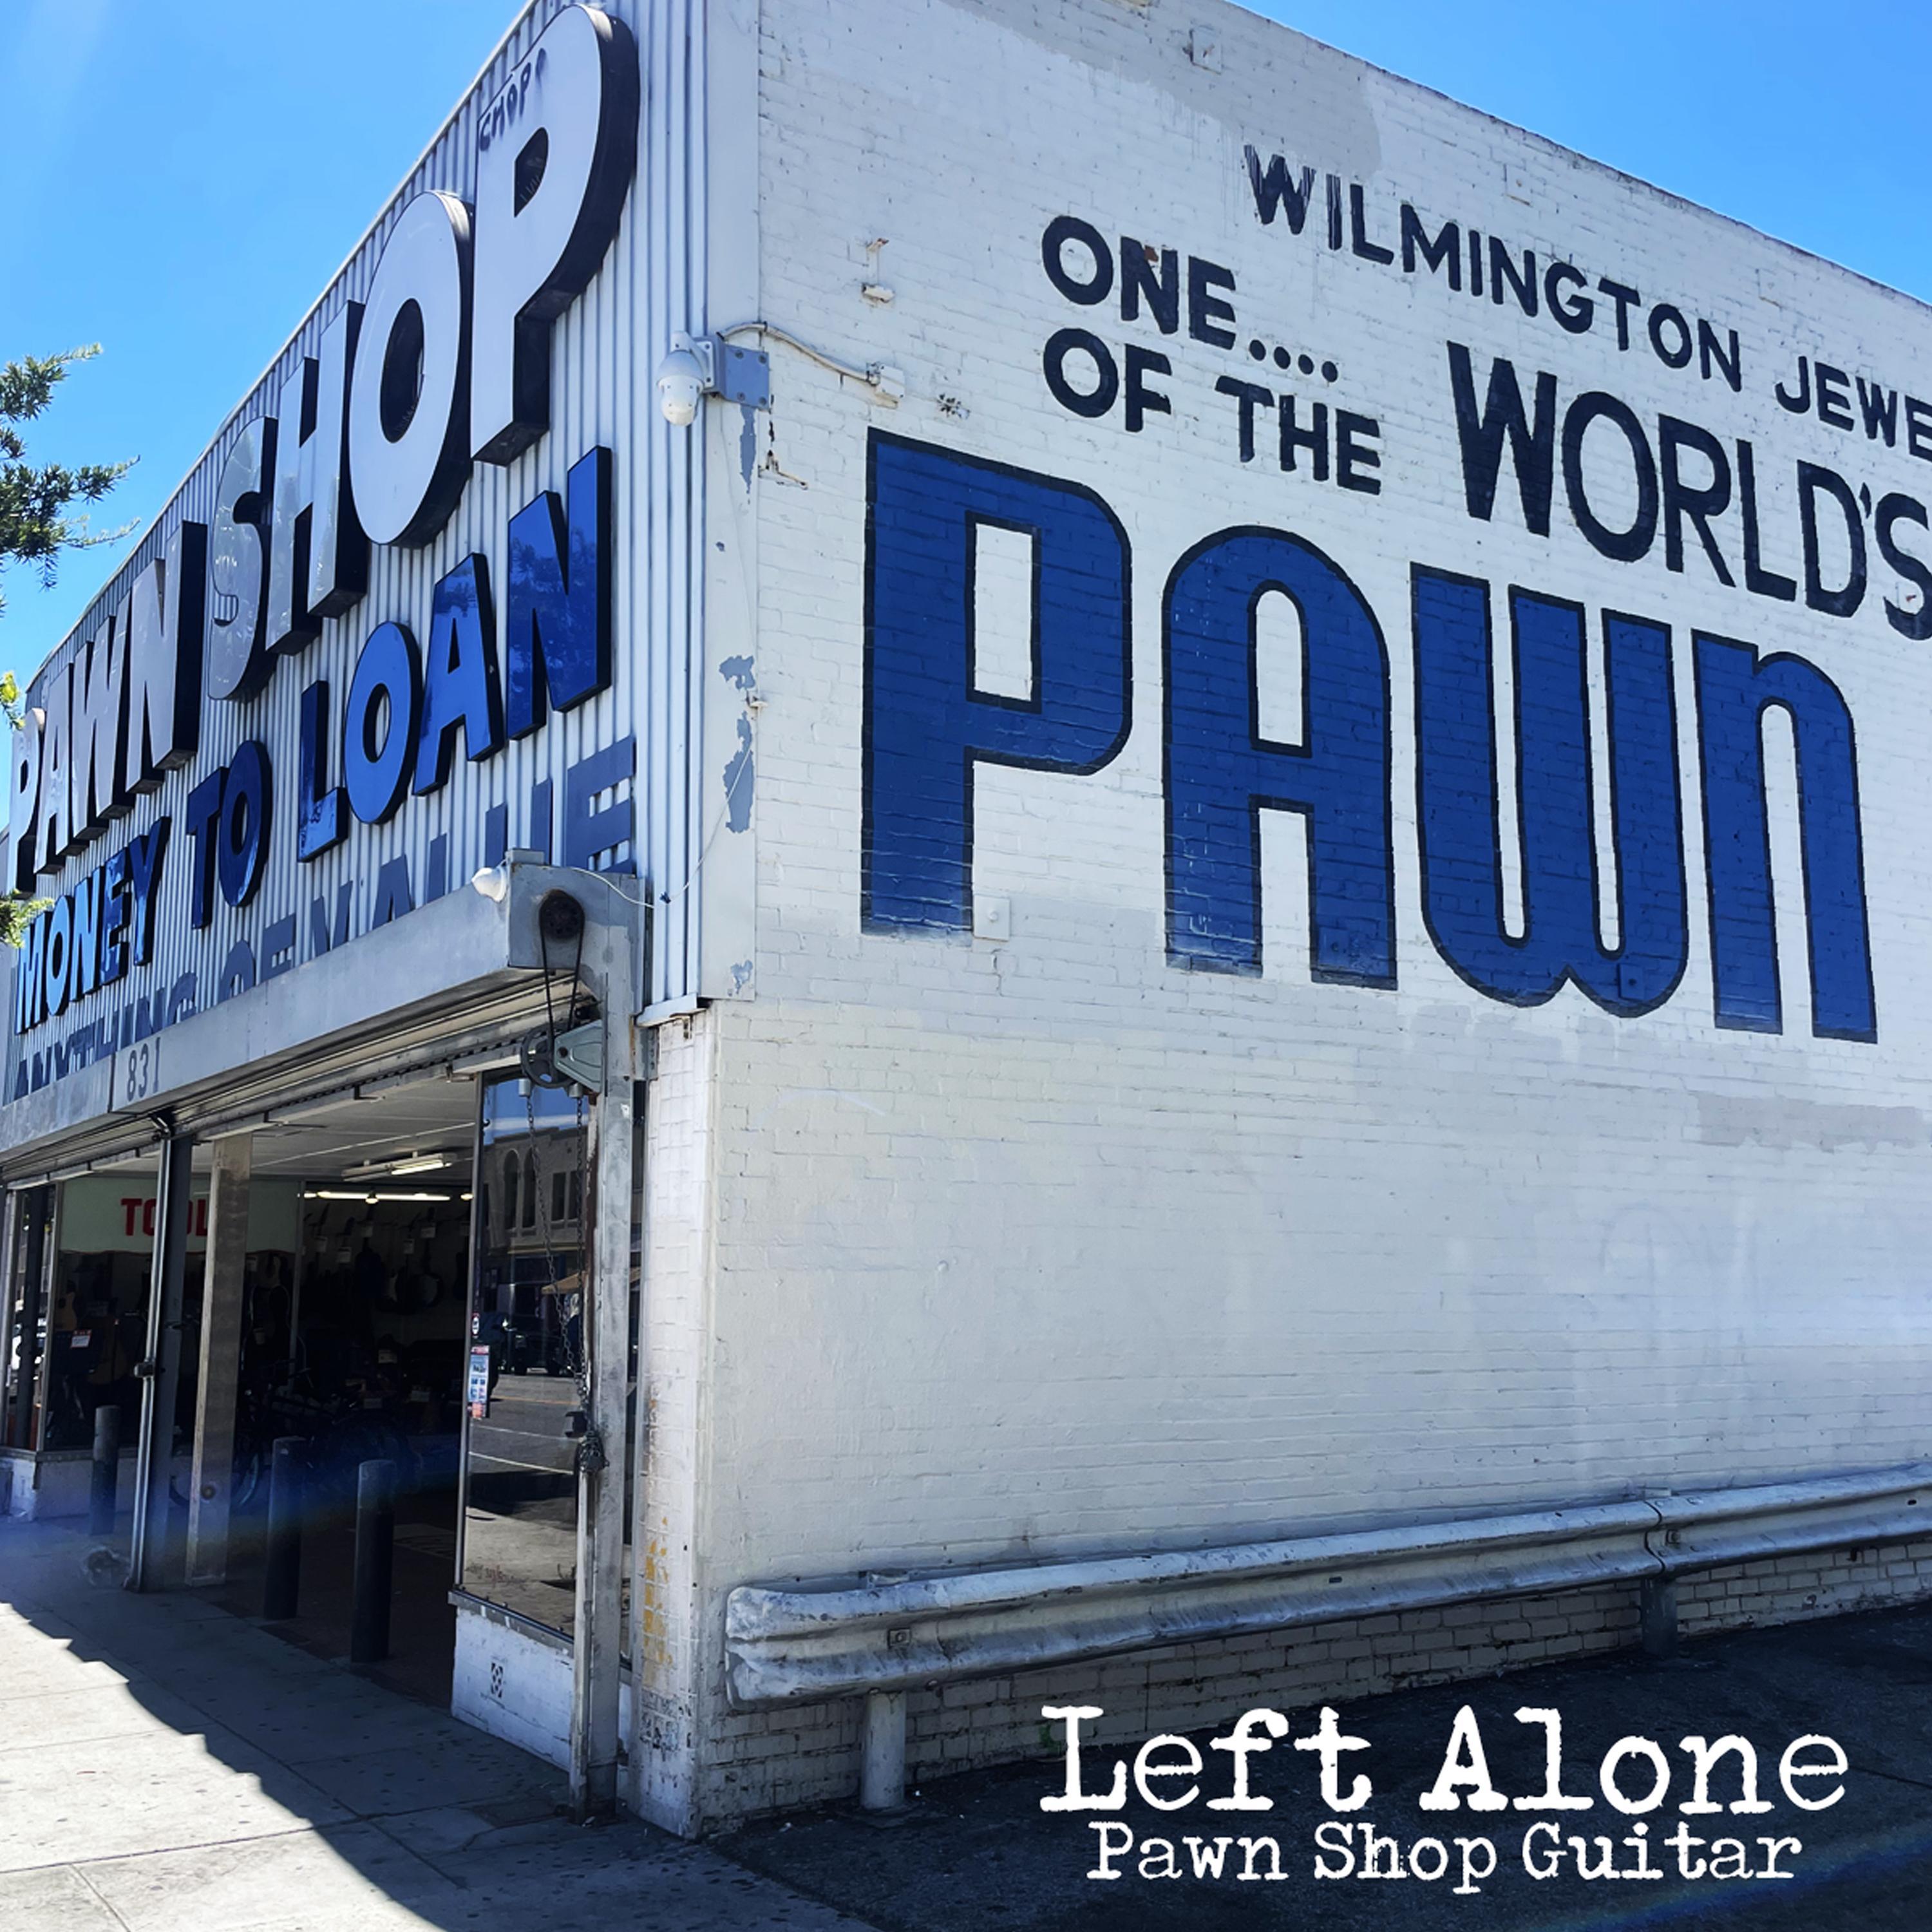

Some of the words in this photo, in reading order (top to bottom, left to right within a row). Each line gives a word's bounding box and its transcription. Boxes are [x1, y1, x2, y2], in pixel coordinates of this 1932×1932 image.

[5, 520, 207, 900] PAWN
[207, 3, 639, 703] SHOP
[1243, 144, 1742, 393] WILMINGTON
[1774, 355, 1932, 461] JEWE
[1043, 328, 1173, 433] OF
[1215, 375, 1381, 495] THE
[1446, 339, 1932, 641] WORLD'S
[15, 816, 172, 1036] MONEY
[186, 740, 273, 929] TO
[298, 445, 612, 863] LOAN
[121, 1198, 208, 1236] TOL
[127, 1036, 161, 1102] 831
